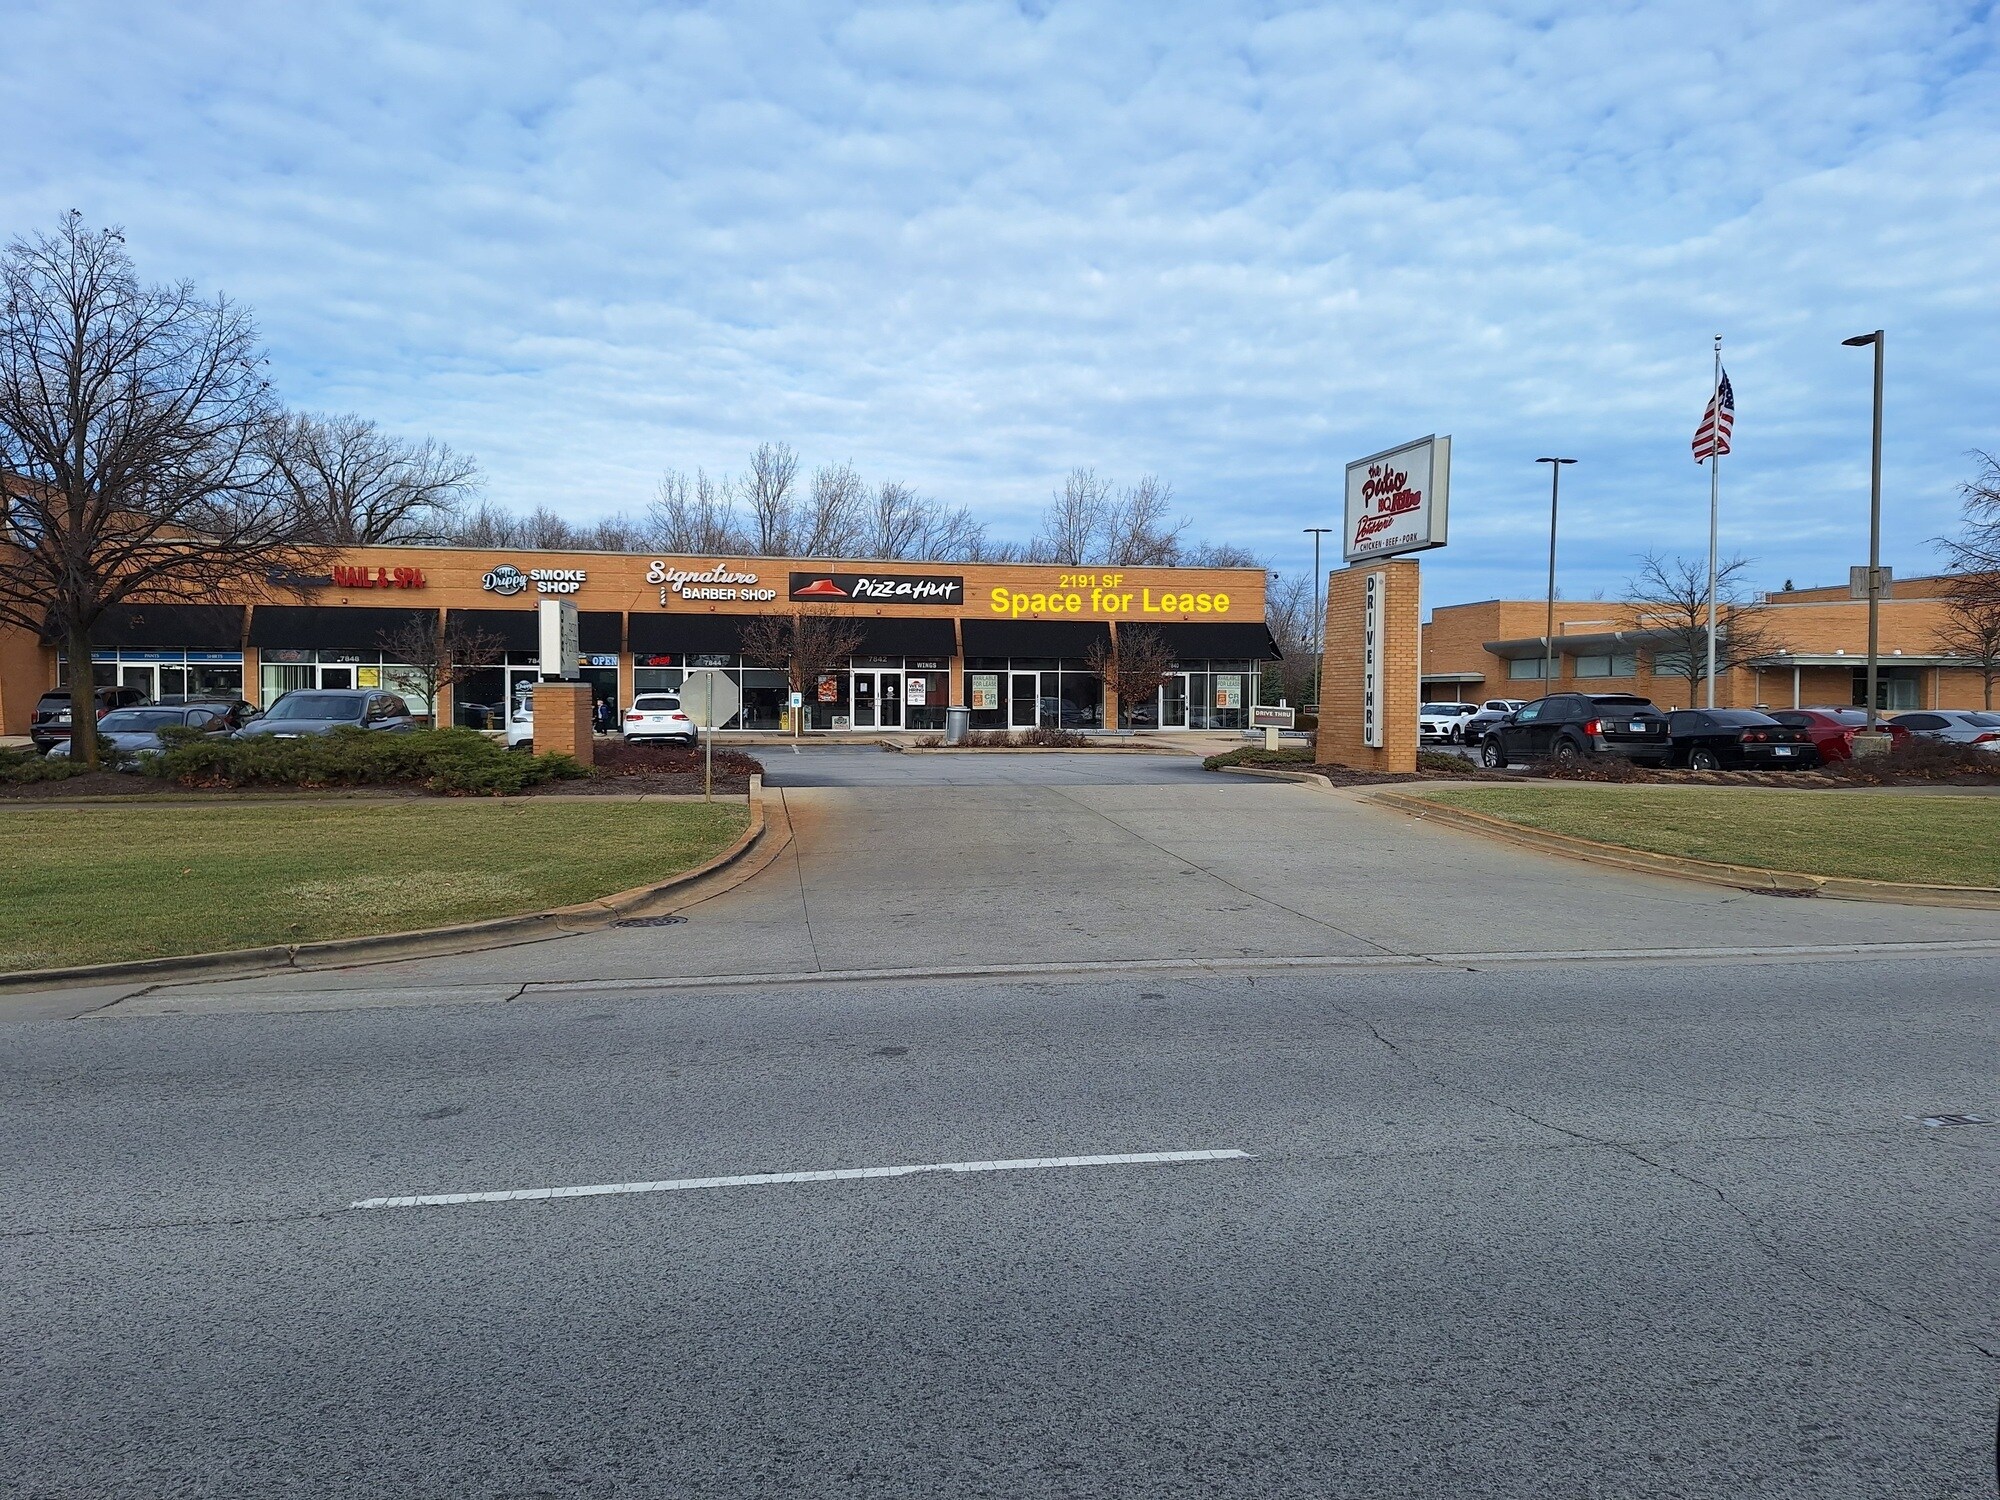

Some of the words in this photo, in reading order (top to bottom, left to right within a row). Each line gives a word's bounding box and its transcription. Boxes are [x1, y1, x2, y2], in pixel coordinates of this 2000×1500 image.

[1360, 539, 1382, 551] CHICKEN
[1385, 536, 1398, 547] BEEF
[1402, 532, 1418, 543] PORK
[333, 566, 373, 588] NAIL
[376, 567, 389, 588] &
[393, 567, 426, 589] SPA
[482, 572, 529, 591] Drippy
[530, 569, 587, 581] SMOKE
[646, 560, 759, 592] Signature
[537, 581, 580, 593] SHOP
[682, 587, 737, 600] BARBER
[740, 589, 776, 601] SHOP
[1366, 577, 1375, 664] DRIVE
[592, 656, 618, 665] OPEN
